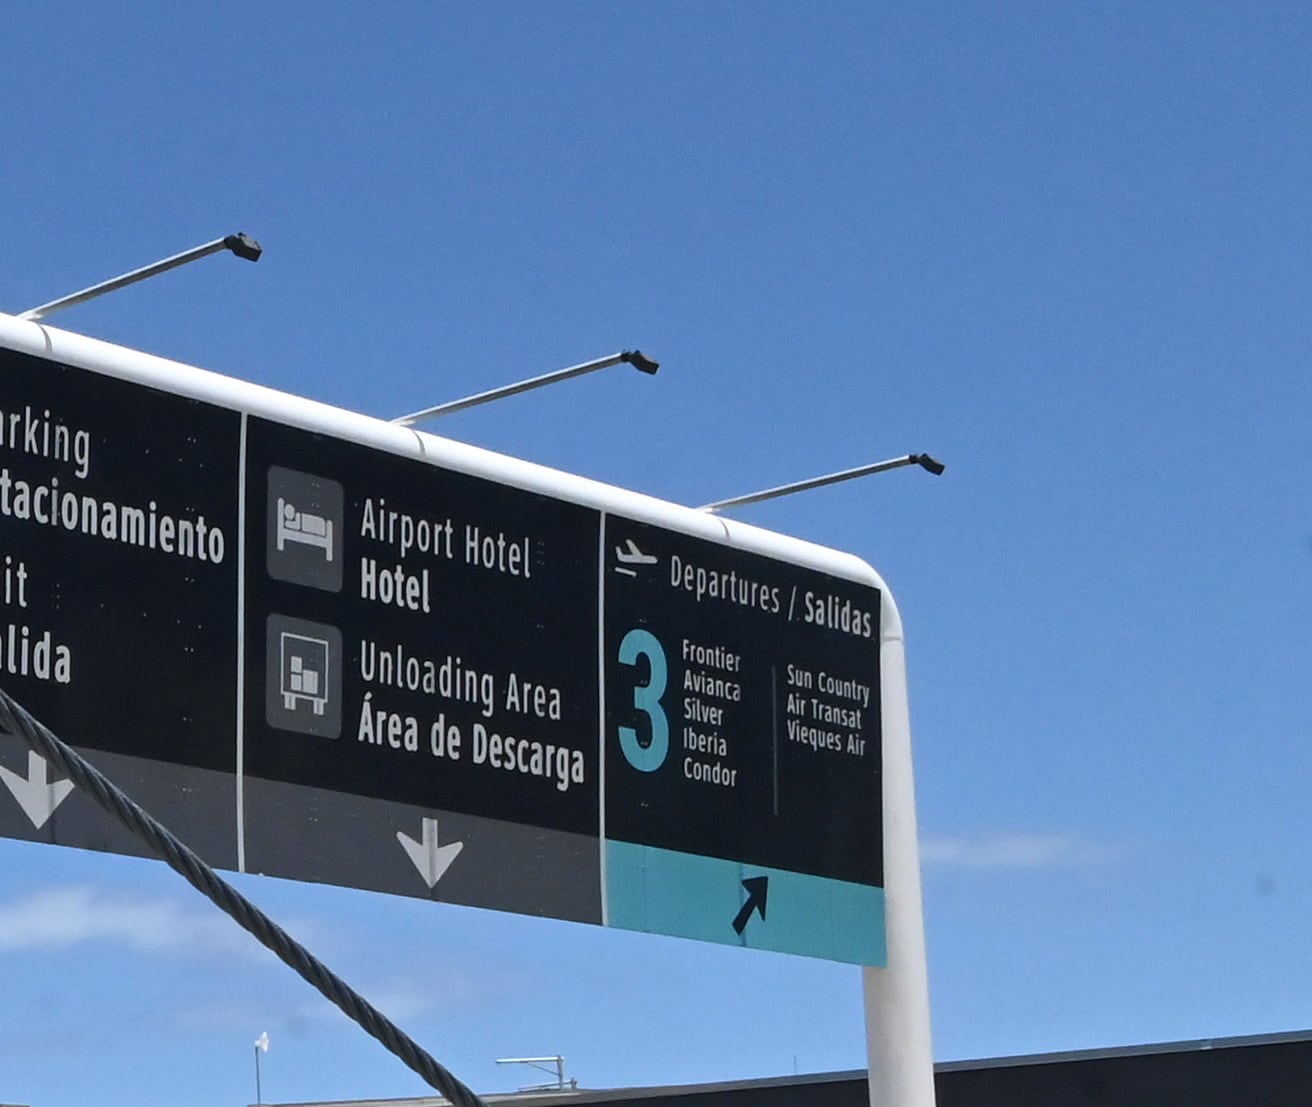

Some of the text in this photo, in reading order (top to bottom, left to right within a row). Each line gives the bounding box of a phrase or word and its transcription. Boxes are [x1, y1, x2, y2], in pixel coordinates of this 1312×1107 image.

[360, 498, 531, 579] Airport Hotel
[360, 557, 431, 613] Hotel
[670, 555, 780, 615] Departures
[804, 591, 872, 639] Salidas
[682, 639, 741, 674] Frontier
[360, 639, 561, 721] Unloading Area
[617, 628, 669, 773] 3
[683, 670, 742, 702] Avianca
[787, 664, 870, 709] Sun Country
[683, 700, 724, 727] Silver
[786, 693, 863, 731] Air Transat
[357, 691, 585, 792] Área de Descarga
[683, 728, 727, 757] Iberia
[786, 719, 866, 757] Vieques Air
[683, 756, 737, 788] Condor
